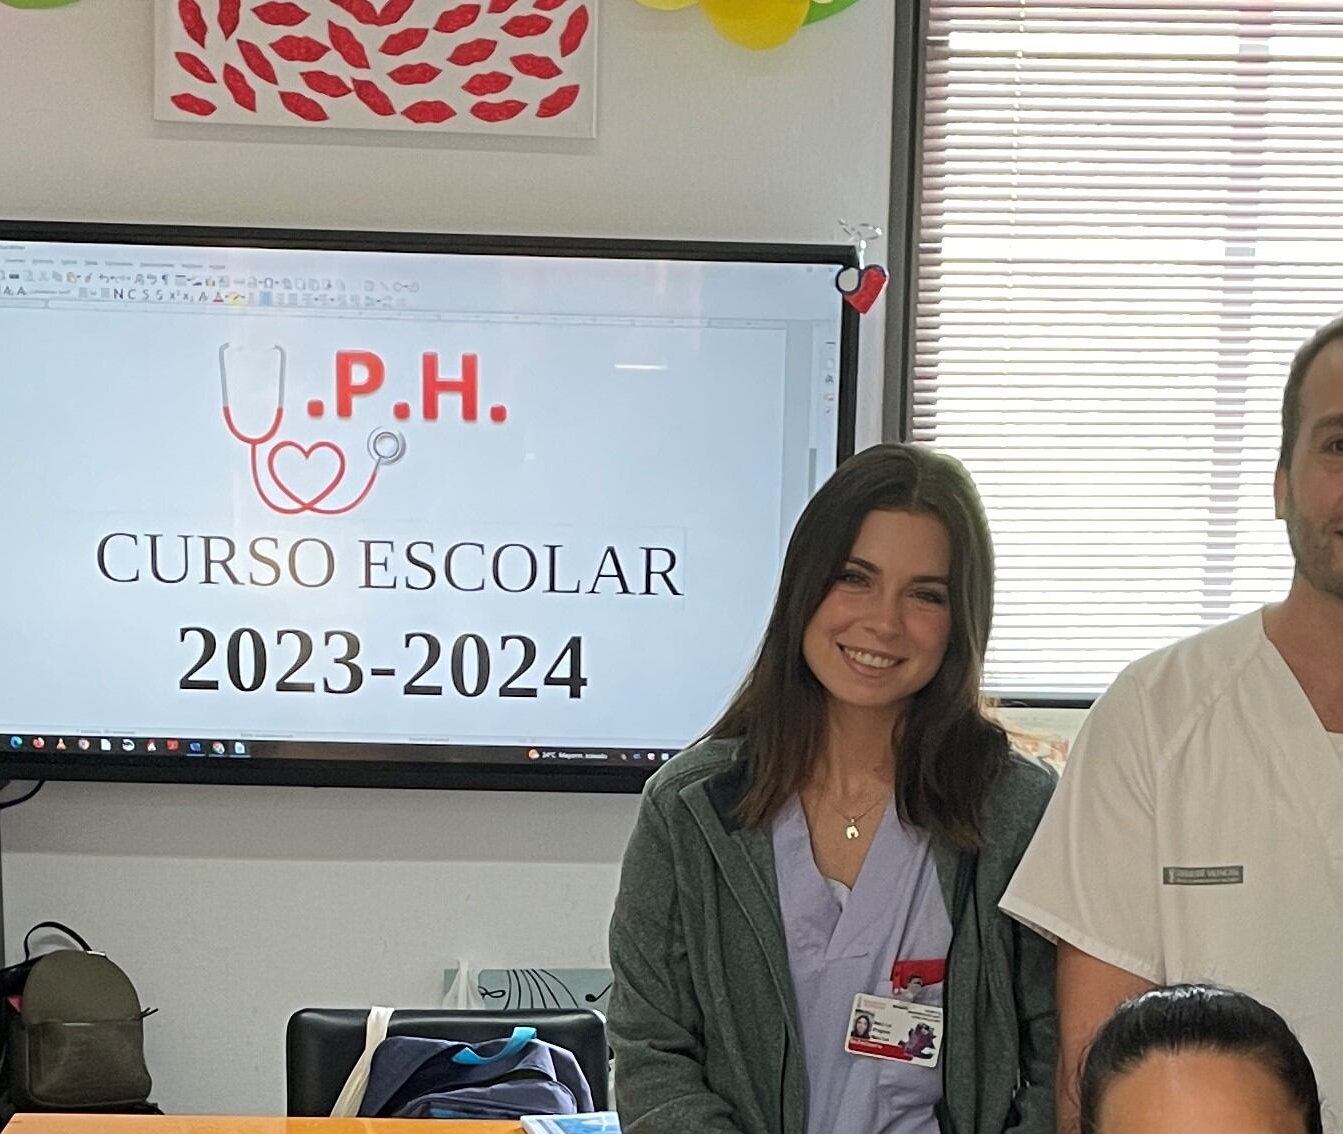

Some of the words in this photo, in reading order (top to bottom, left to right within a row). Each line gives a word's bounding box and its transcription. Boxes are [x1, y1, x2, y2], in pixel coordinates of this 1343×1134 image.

[97, 531, 336, 590] CURSO
[358, 539, 685, 597] ESCOLAR
[177, 625, 589, 700] 2023-2024
